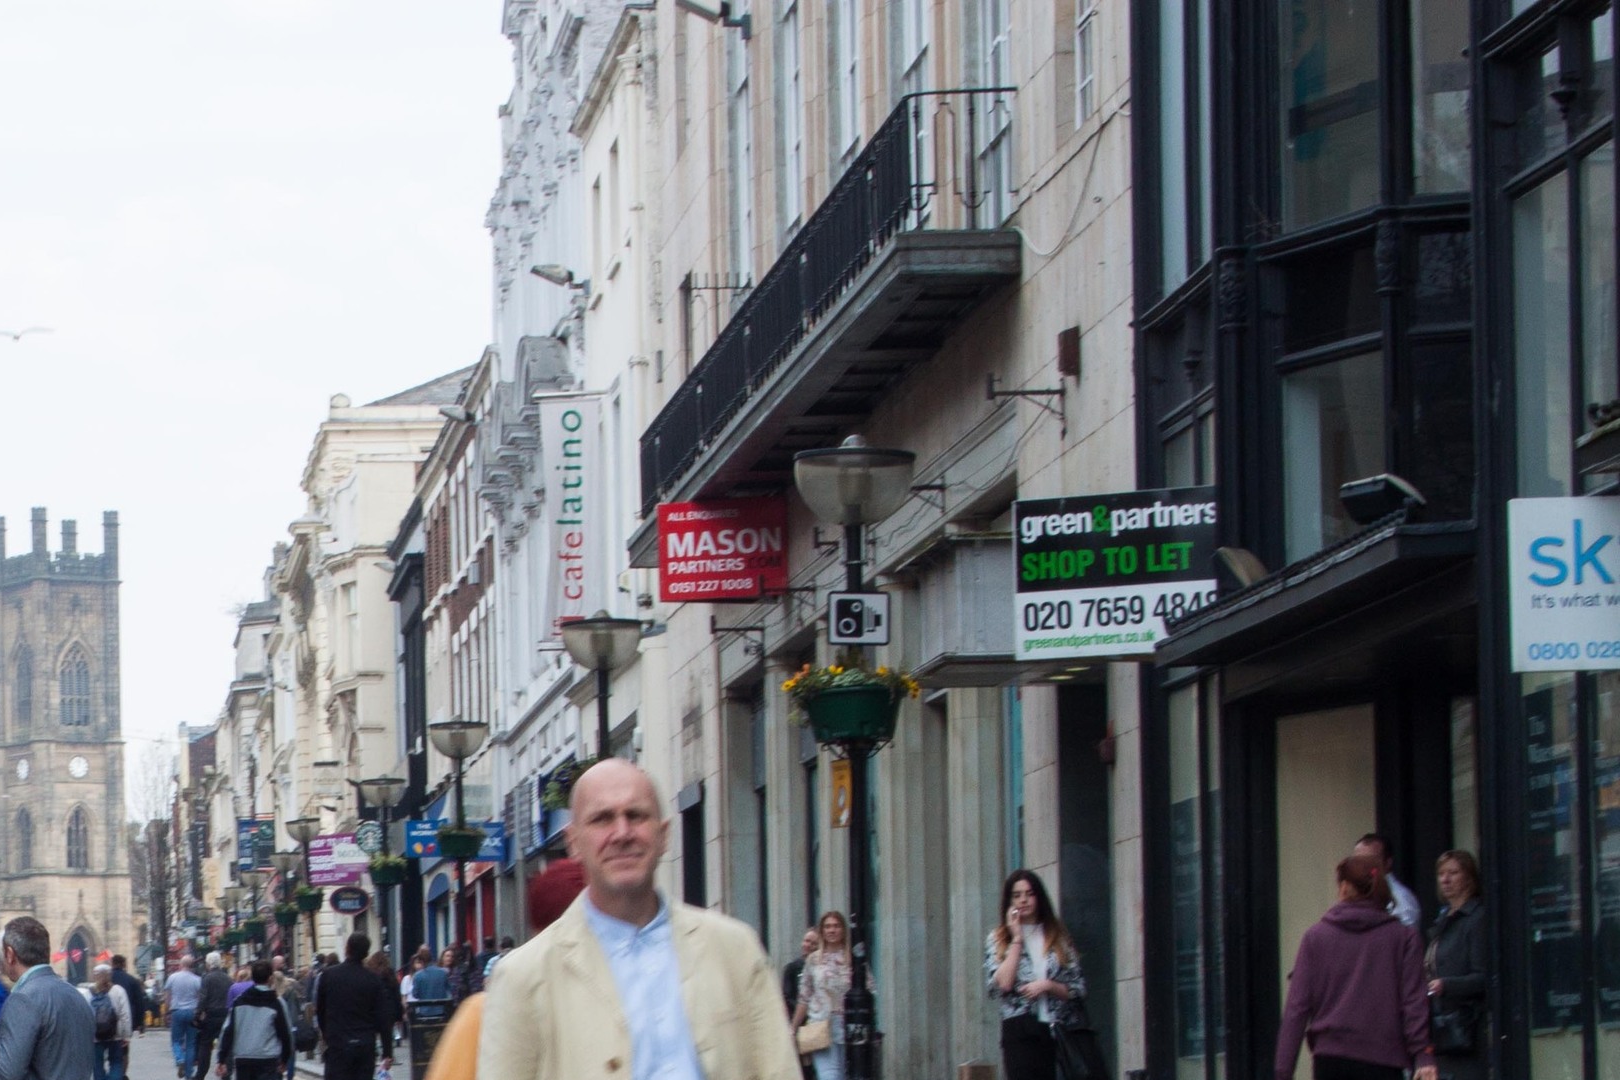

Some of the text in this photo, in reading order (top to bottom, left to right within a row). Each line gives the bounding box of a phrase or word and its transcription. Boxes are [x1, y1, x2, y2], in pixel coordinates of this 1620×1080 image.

[667, 511, 685, 522] ALL
[667, 527, 781, 558] MASON
[1022, 541, 1193, 582] SHOP TO LET
[1529, 518, 1620, 587] sk
[668, 558, 745, 575] PARTNERS
[669, 581, 696, 594] 0151
[697, 580, 719, 592] 227
[1531, 594, 1556, 608] It's
[1561, 592, 1600, 607] what
[1024, 600, 1072, 631] 020
[1080, 595, 1145, 628] 7659
[1529, 643, 1579, 661] 0800
